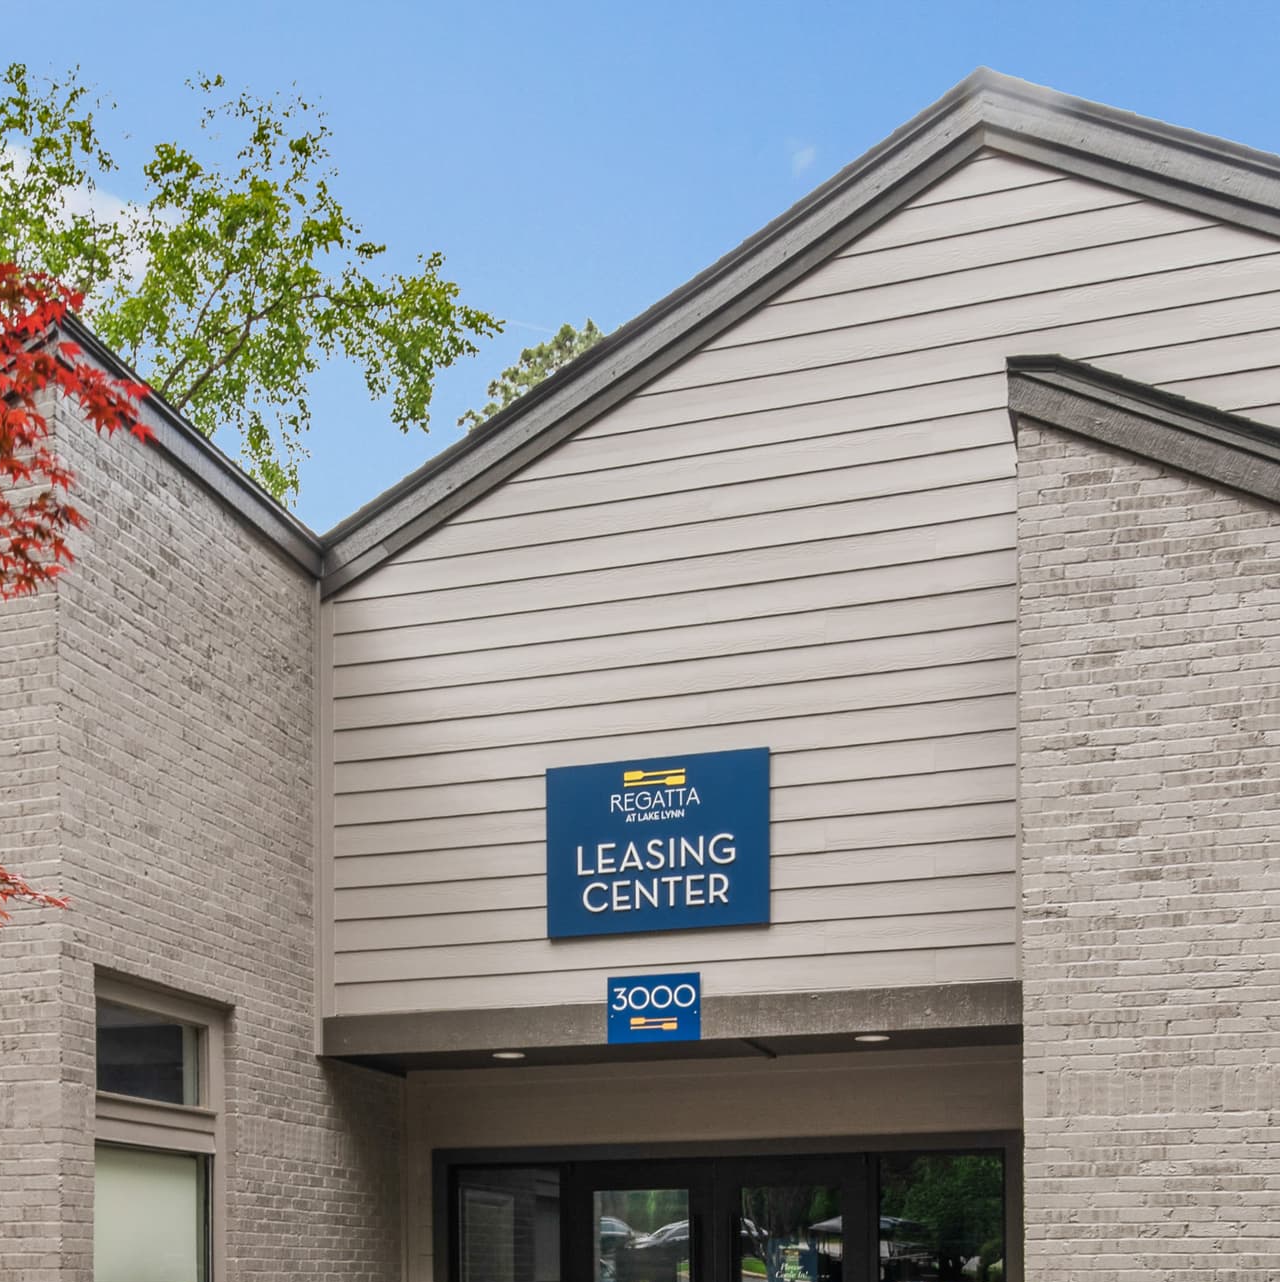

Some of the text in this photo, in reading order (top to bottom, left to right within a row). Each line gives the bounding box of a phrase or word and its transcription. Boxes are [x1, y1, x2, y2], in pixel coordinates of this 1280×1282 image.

[610, 787, 701, 813] REGATTA
[625, 809, 685, 823] AT LAKE LYNN
[577, 833, 736, 876] LEASING
[582, 873, 730, 912] CENTER
[612, 984, 696, 1011] 3000
